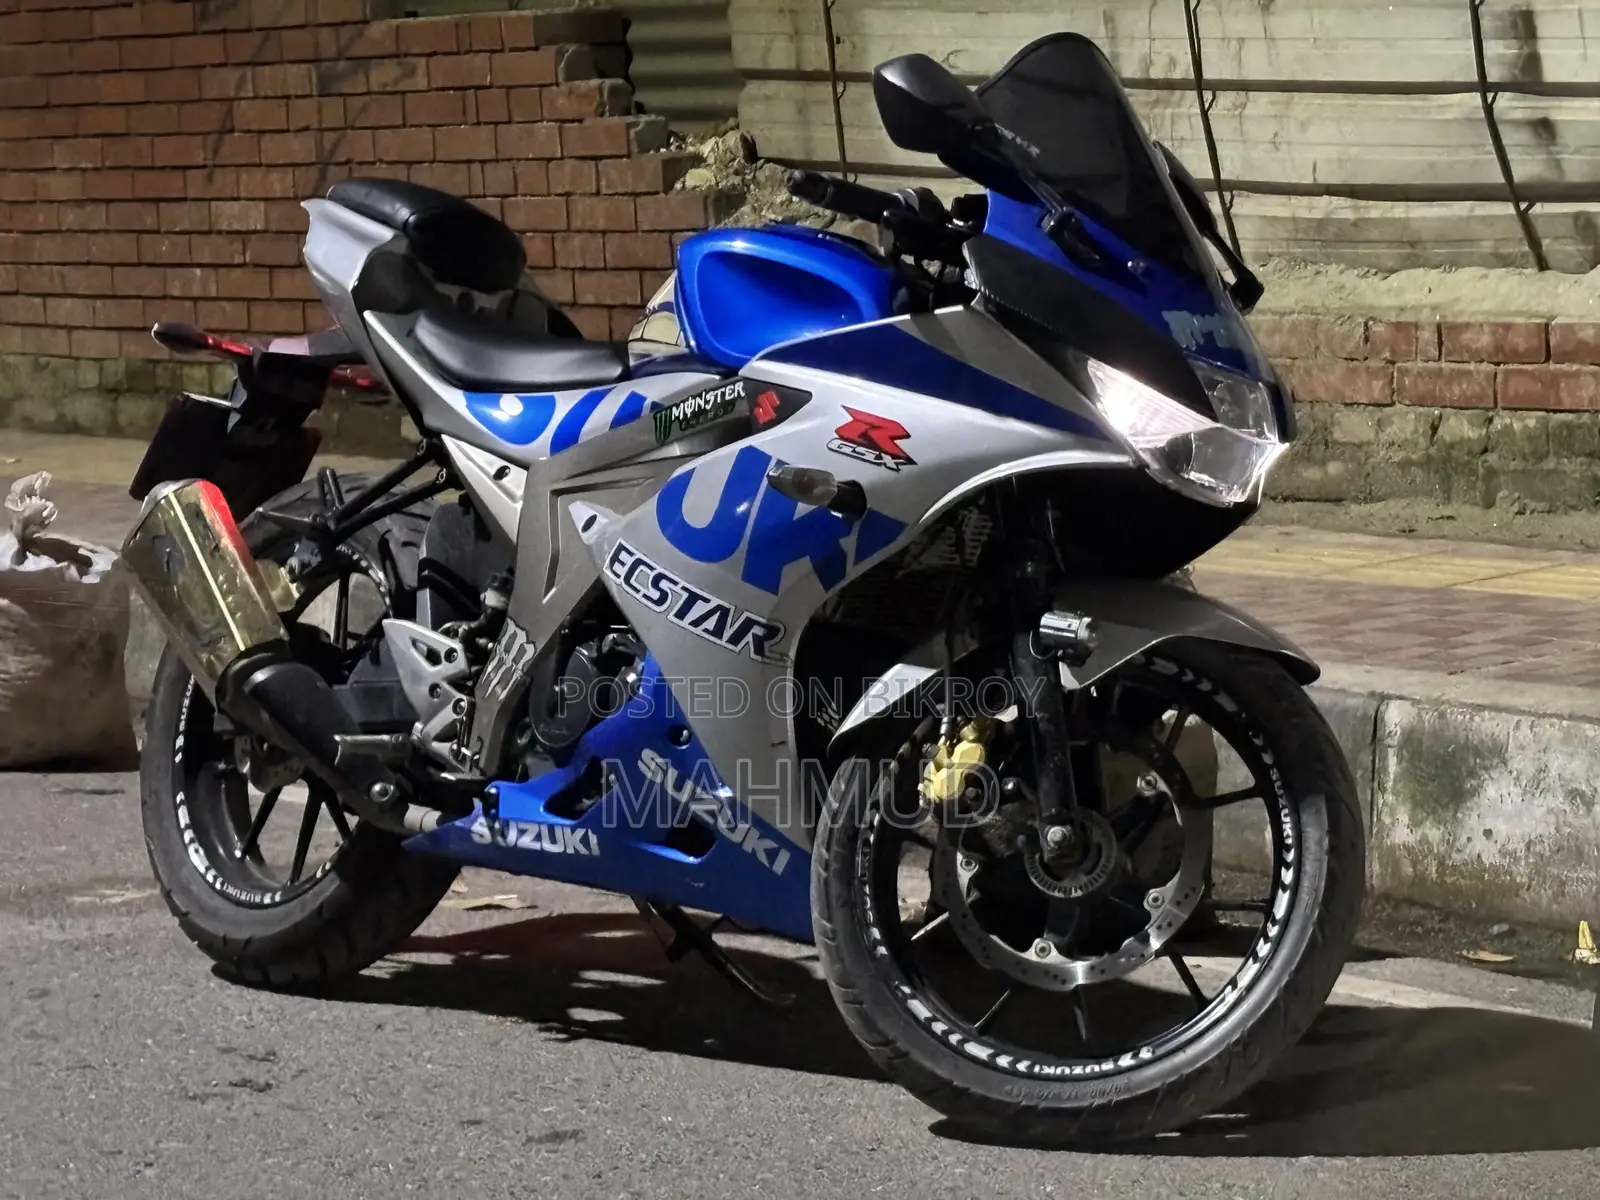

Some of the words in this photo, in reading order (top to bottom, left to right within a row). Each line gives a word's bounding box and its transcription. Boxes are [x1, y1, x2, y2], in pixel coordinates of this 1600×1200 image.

[671, 380, 746, 422] MONSTER
[602, 539, 794, 666] ECSTAR
[637, 747, 792, 877] SUZUKI
[1269, 766, 1294, 845] SUZUKI
[470, 815, 600, 857] SUZUKI
[1033, 1059, 1115, 1076] SUZUKI
